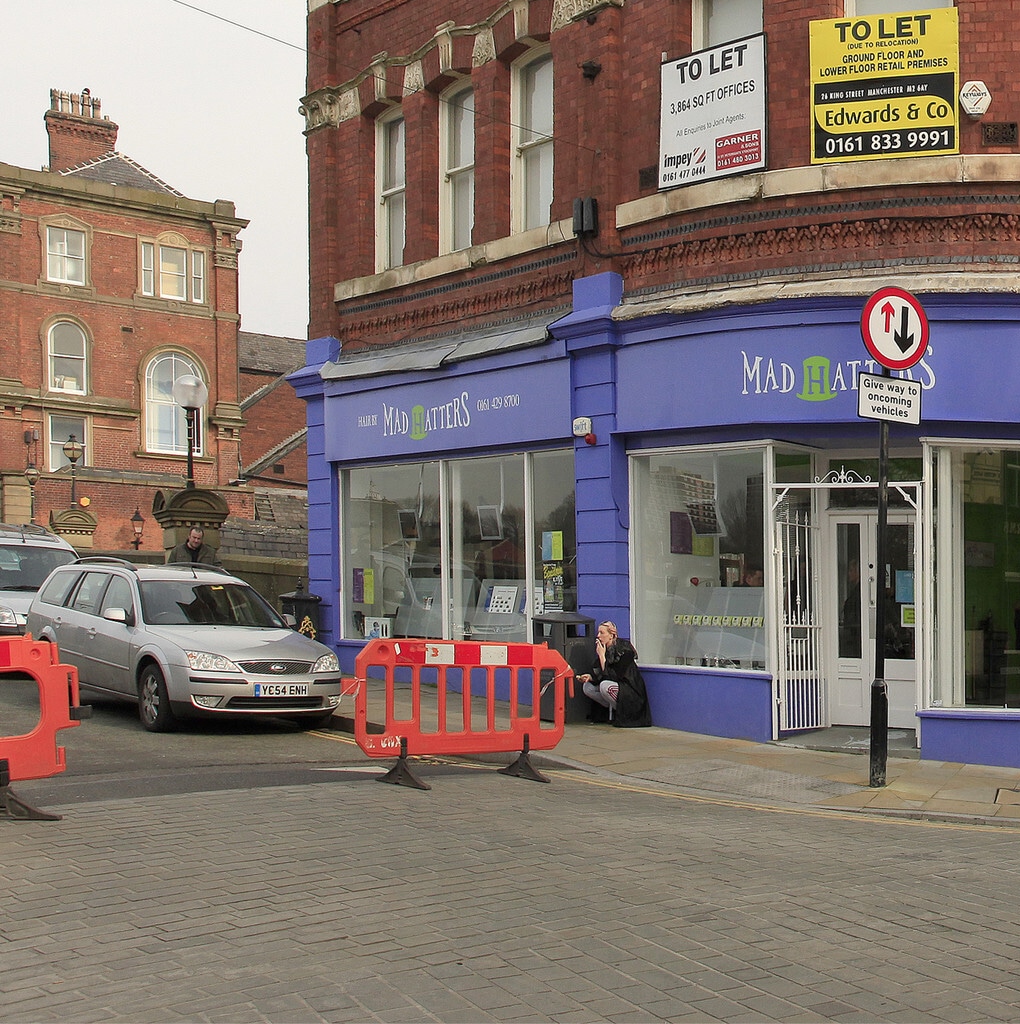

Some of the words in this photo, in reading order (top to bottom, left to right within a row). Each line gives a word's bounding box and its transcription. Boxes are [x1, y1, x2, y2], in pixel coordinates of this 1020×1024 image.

[835, 20, 871, 42] TO
[878, 14, 931, 39] LET
[847, 42, 862, 50] (DUE
[875, 38, 919, 48] RELOCATION)
[677, 58, 702, 84] TO
[709, 44, 748, 75] LET
[842, 52, 876, 64] GROUND
[877, 50, 905, 61] FLOOR
[907, 49, 924, 59] AND
[819, 65, 847, 77] LOWER
[849, 63, 876, 74] FLOOR
[877, 60, 905, 72] RETAIL
[907, 57, 948, 69] PREMISES
[670, 100, 691, 116] 3,864
[692, 94, 704, 108] SQ
[705, 90, 716, 104] FT
[716, 79, 756, 100] OFFICES
[829, 91, 844, 100] KING
[845, 89, 864, 98] STREET
[867, 86, 903, 97] MANCHESTER
[906, 85, 916, 93] M2
[825, 104, 900, 127] Edwards
[906, 103, 920, 121] &
[926, 101, 948, 119] Co
[684, 123, 707, 137] Enquiries
[706, 121, 712, 130] to
[712, 117, 725, 128] Joint
[725, 113, 747, 126] Agents:
[717, 133, 759, 148] GARNER
[825, 136, 863, 154] 0161
[871, 133, 901, 151] 833
[907, 130, 949, 148] 9991
[664, 151, 693, 169] impey
[718, 158, 731, 166] 0161
[732, 155, 744, 163] 480
[744, 153, 759, 162] 3013
[663, 171, 677, 183] 0161
[679, 169, 691, 179] 477
[691, 165, 706, 177] 0444
[741, 350, 795, 395] MAD
[863, 378, 884, 390] Give
[887, 383, 905, 396] way
[908, 385, 918, 396] to
[477, 398, 490, 412] 0161
[491, 396, 503, 410] 429
[503, 394, 520, 407] 8700
[867, 393, 912, 408] oncoming
[357, 415, 371, 427] HAIR
[371, 414, 378, 426] BY
[383, 402, 409, 437] MAD
[412, 392, 471, 437] HATTERS
[871, 403, 909, 418] vehicles
[262, 685, 287, 695] YC54
[289, 685, 307, 695] ENH
